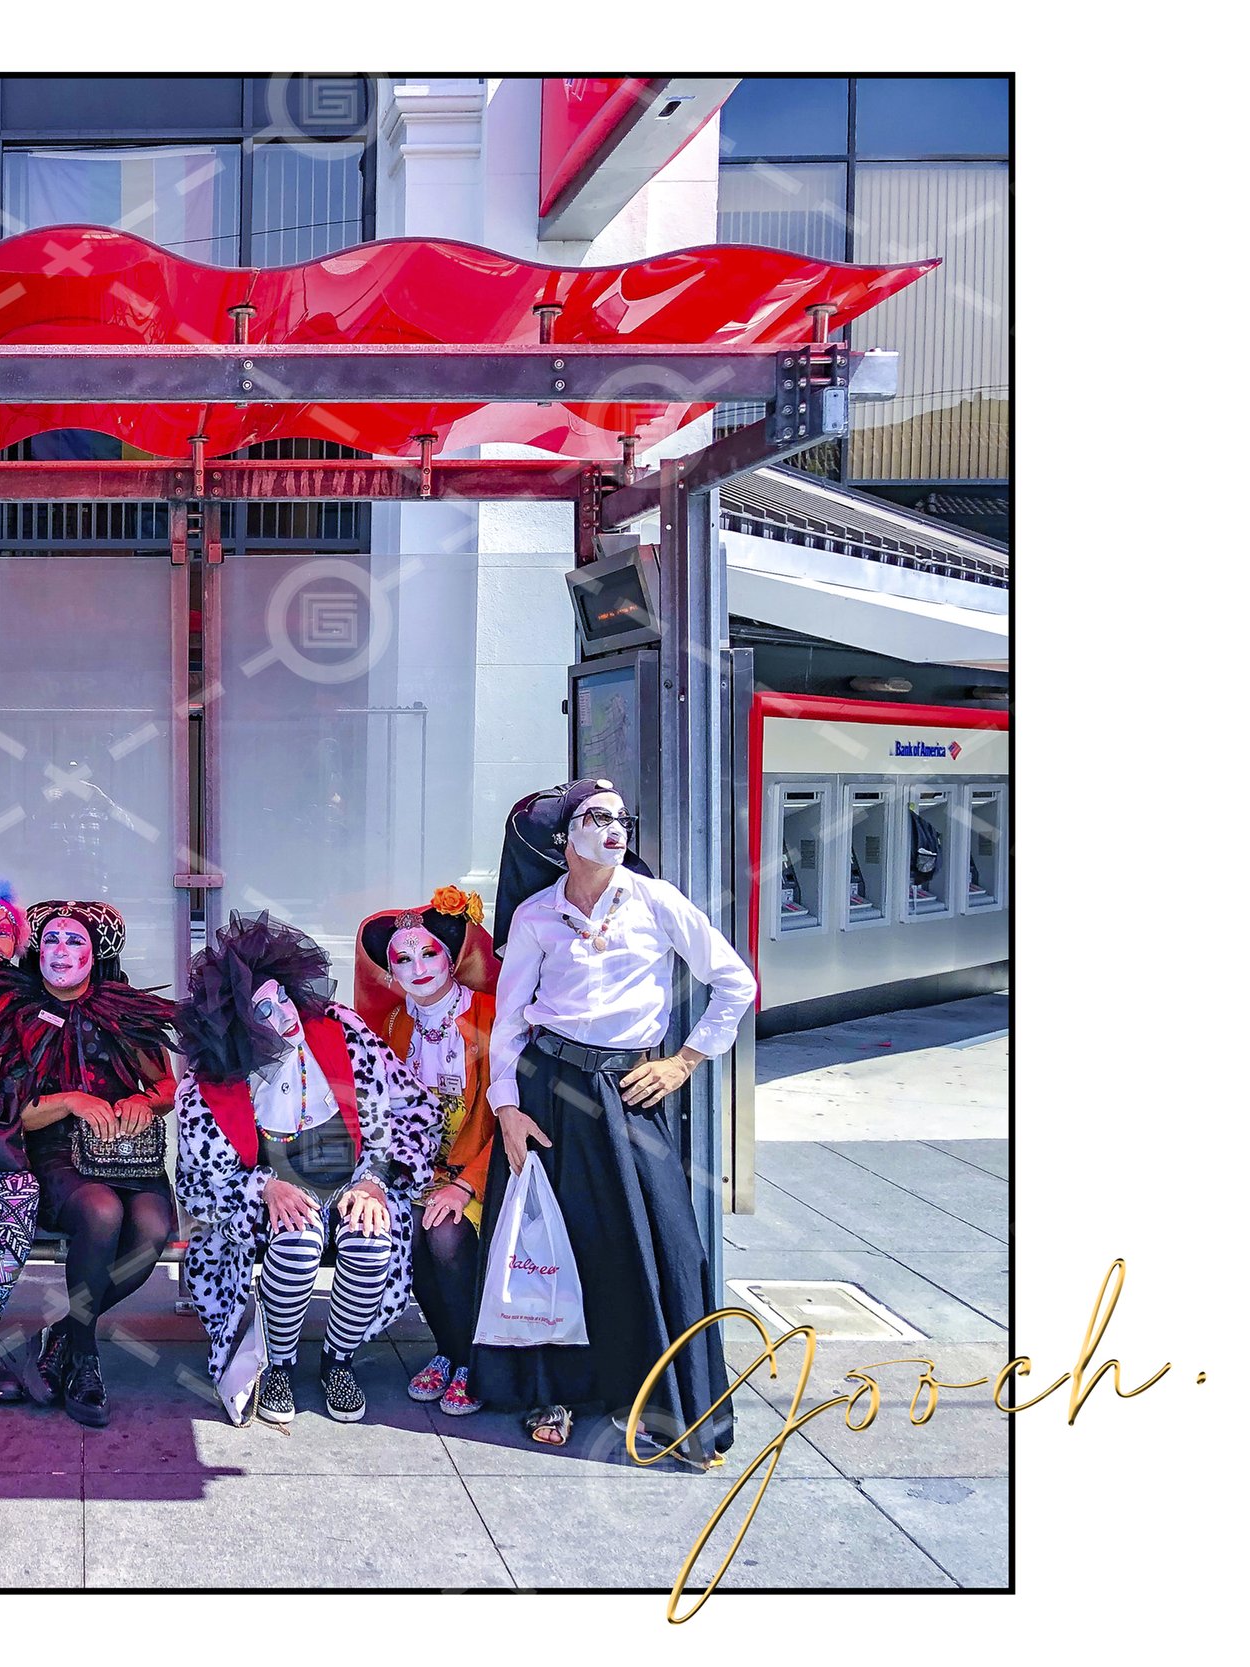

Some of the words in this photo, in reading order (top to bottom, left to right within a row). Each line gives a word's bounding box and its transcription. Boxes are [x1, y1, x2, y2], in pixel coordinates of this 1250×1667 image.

[895, 741, 912, 756] Bank
[913, 741, 920, 756] of
[921, 741, 946, 757] America
